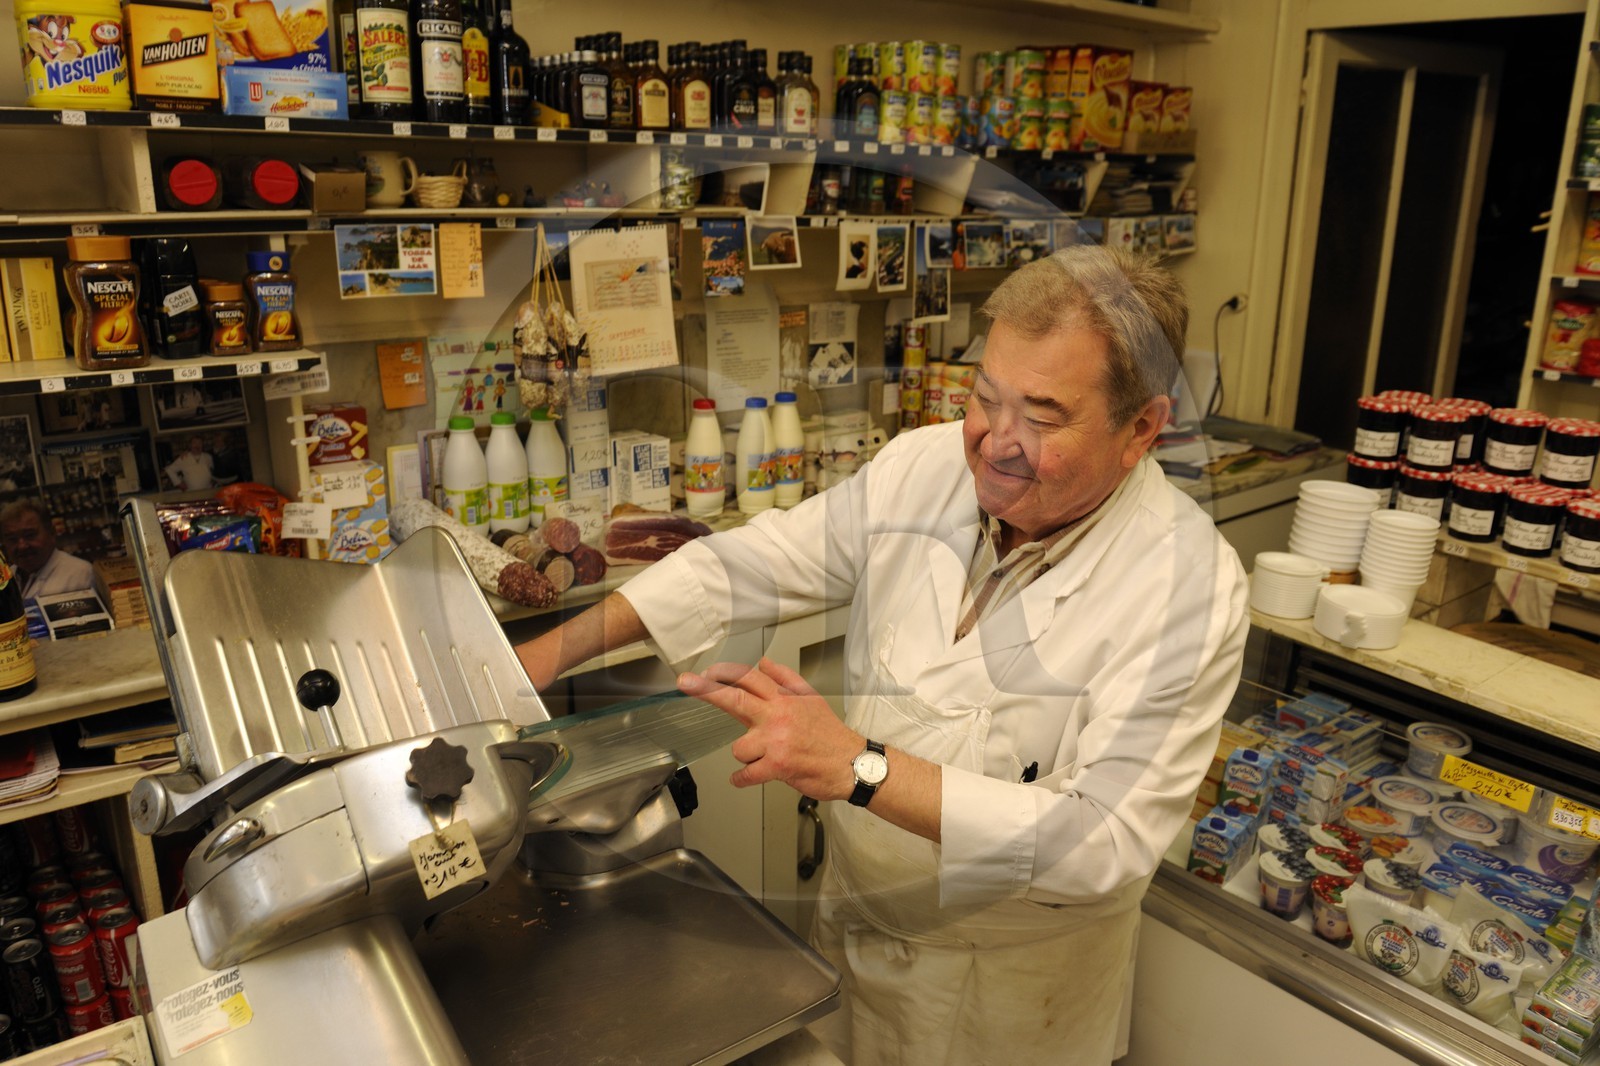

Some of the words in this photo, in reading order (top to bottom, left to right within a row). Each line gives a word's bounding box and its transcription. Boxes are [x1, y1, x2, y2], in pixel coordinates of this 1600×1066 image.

[364, 28, 407, 47] SALERS
[46, 44, 121, 90] Nesquik
[308, 53, 327, 64] 97%
[87, 280, 134, 294] NESCAFÉ
[94, 294, 129, 303] SPECIAL
[317, 421, 347, 437] Belin
[340, 532, 369, 548] Belin
[1431, 870, 1485, 893] Gerta
[1511, 872, 1566, 896] Gervita
[1491, 895, 1547, 919] Gervita
